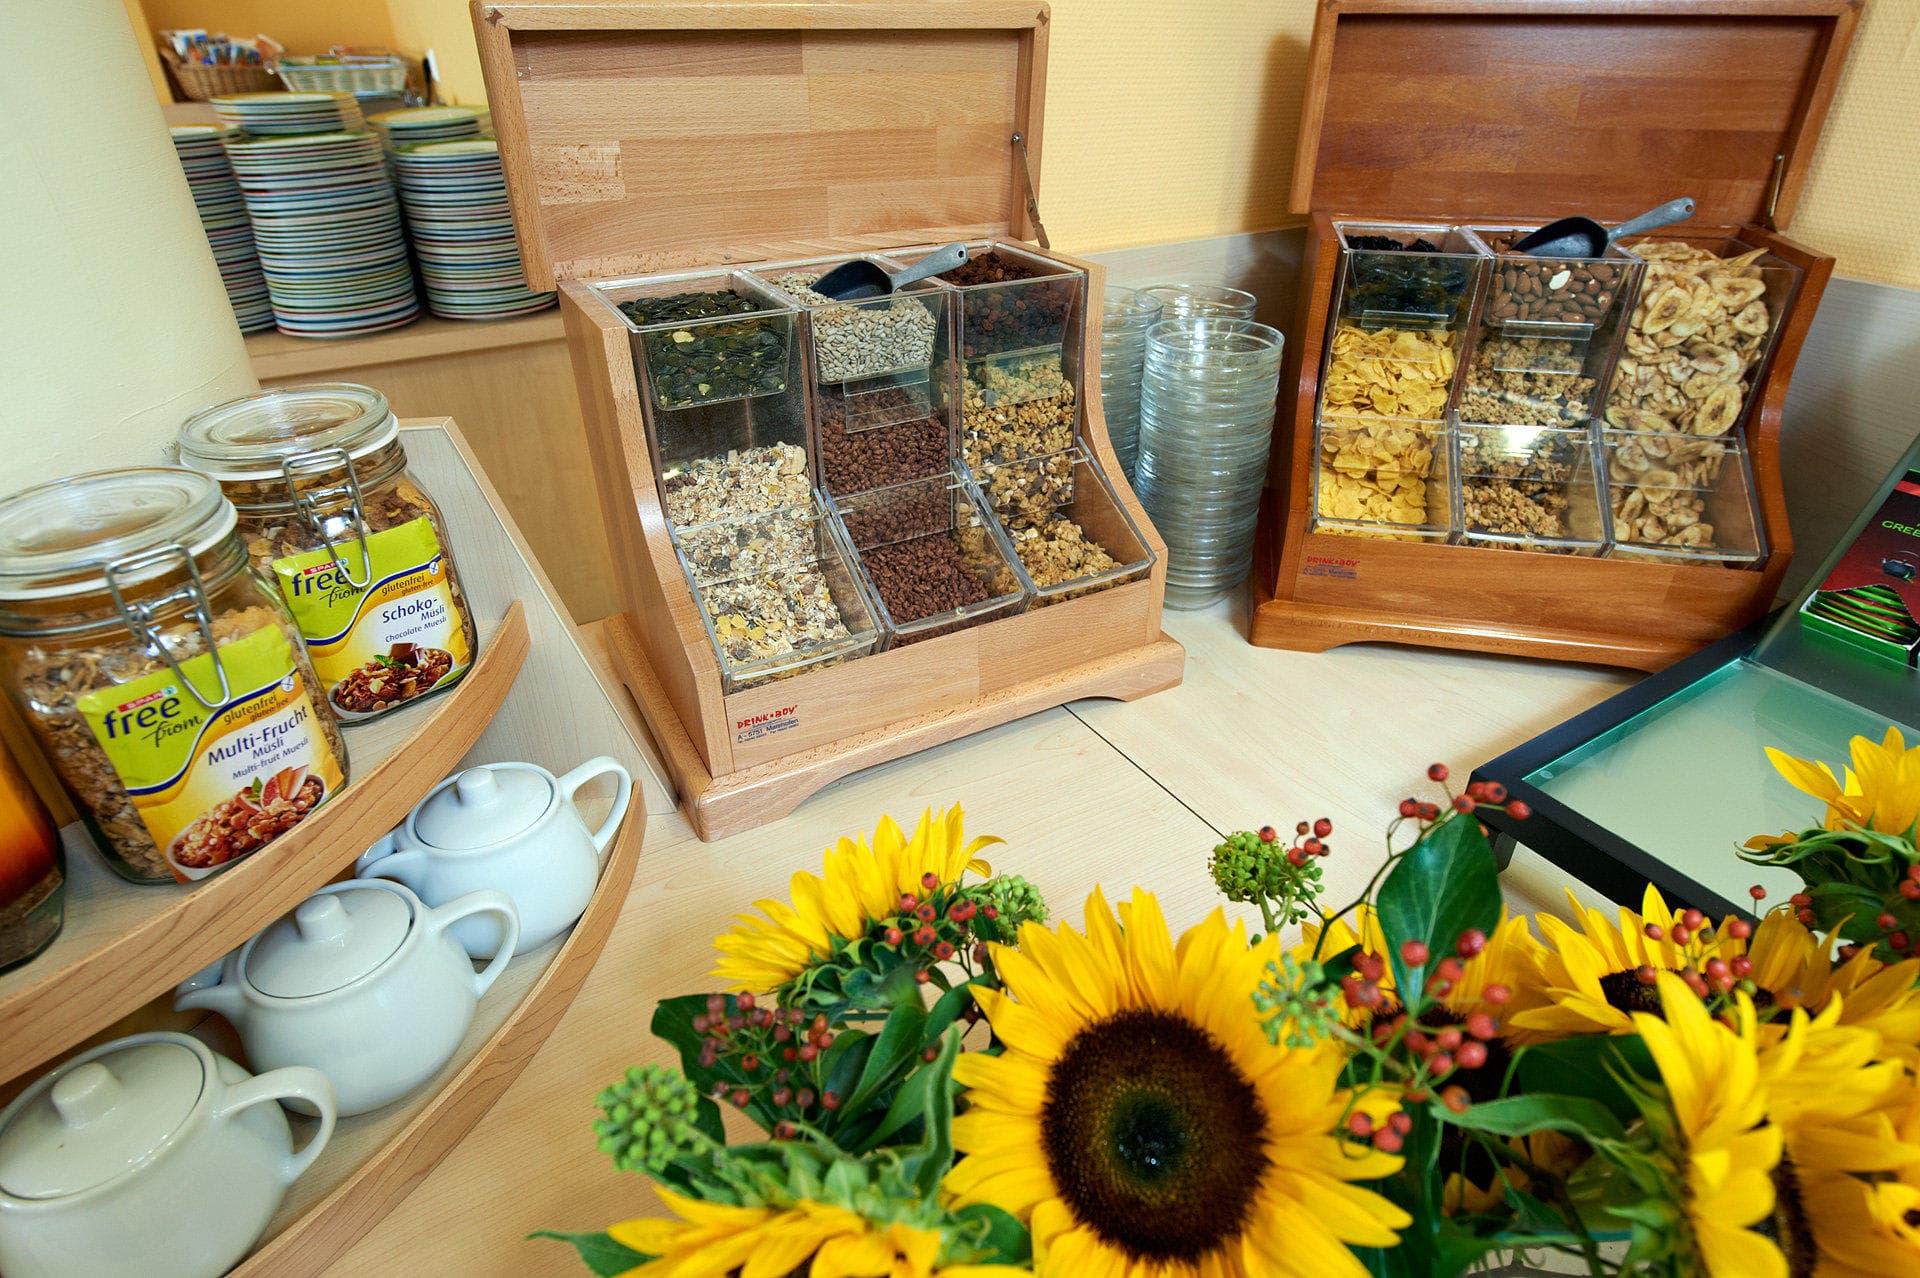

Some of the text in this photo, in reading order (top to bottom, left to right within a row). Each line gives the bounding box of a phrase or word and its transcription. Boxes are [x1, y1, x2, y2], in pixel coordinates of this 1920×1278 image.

[292, 568, 350, 597] free
[382, 574, 425, 597] glutenfrei
[319, 586, 366, 609] from
[383, 599, 438, 624] Schoko-
[421, 604, 445, 621] Müsli
[386, 615, 447, 643] Chocolate Muesli
[103, 697, 181, 739] free
[223, 692, 278, 726] glutenfrei
[141, 715, 202, 748] from
[208, 705, 308, 766] Multi-Frucht
[232, 735, 309, 779] Multi-fruit Muesli
[252, 737, 284, 760] Müsli
